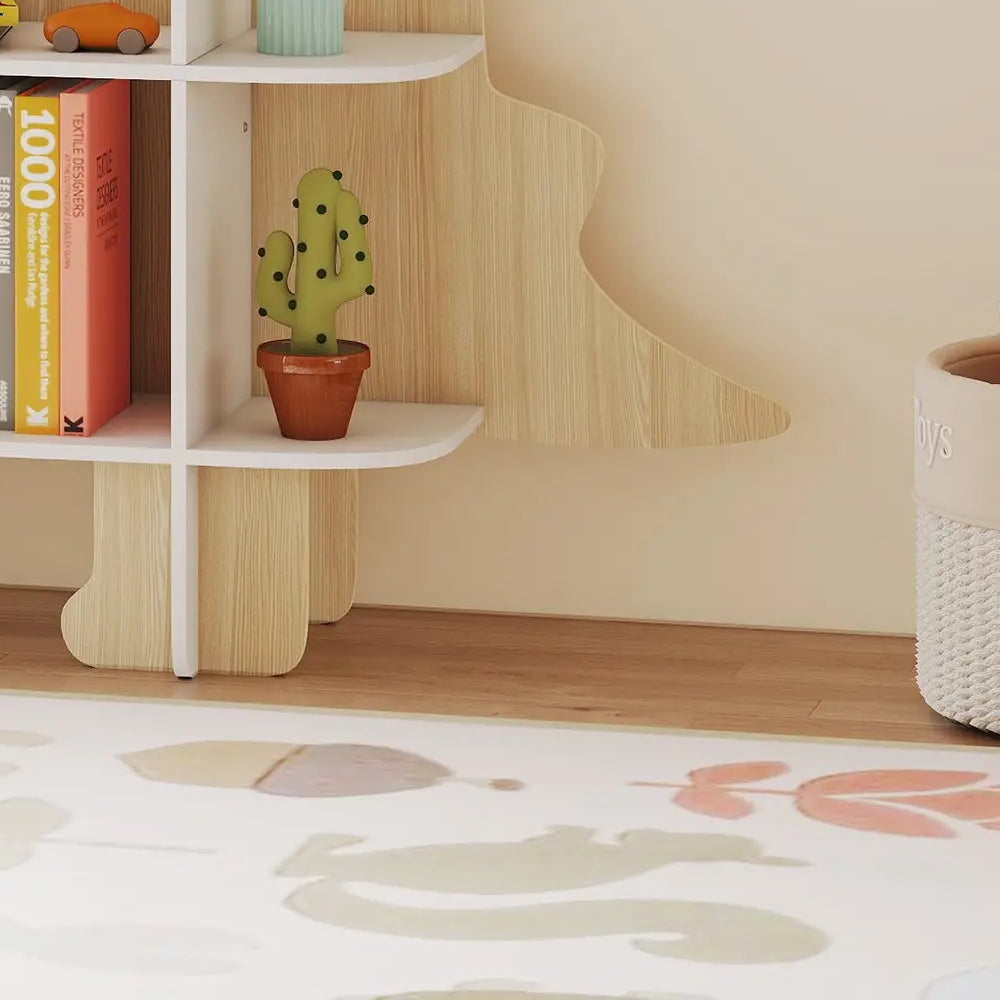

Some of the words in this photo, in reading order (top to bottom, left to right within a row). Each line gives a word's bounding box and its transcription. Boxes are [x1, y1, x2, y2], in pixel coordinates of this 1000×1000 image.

[20, 108, 56, 209] 1000
[73, 112, 85, 155] TEXTILE
[73, 157, 85, 218] DESIGNERS
